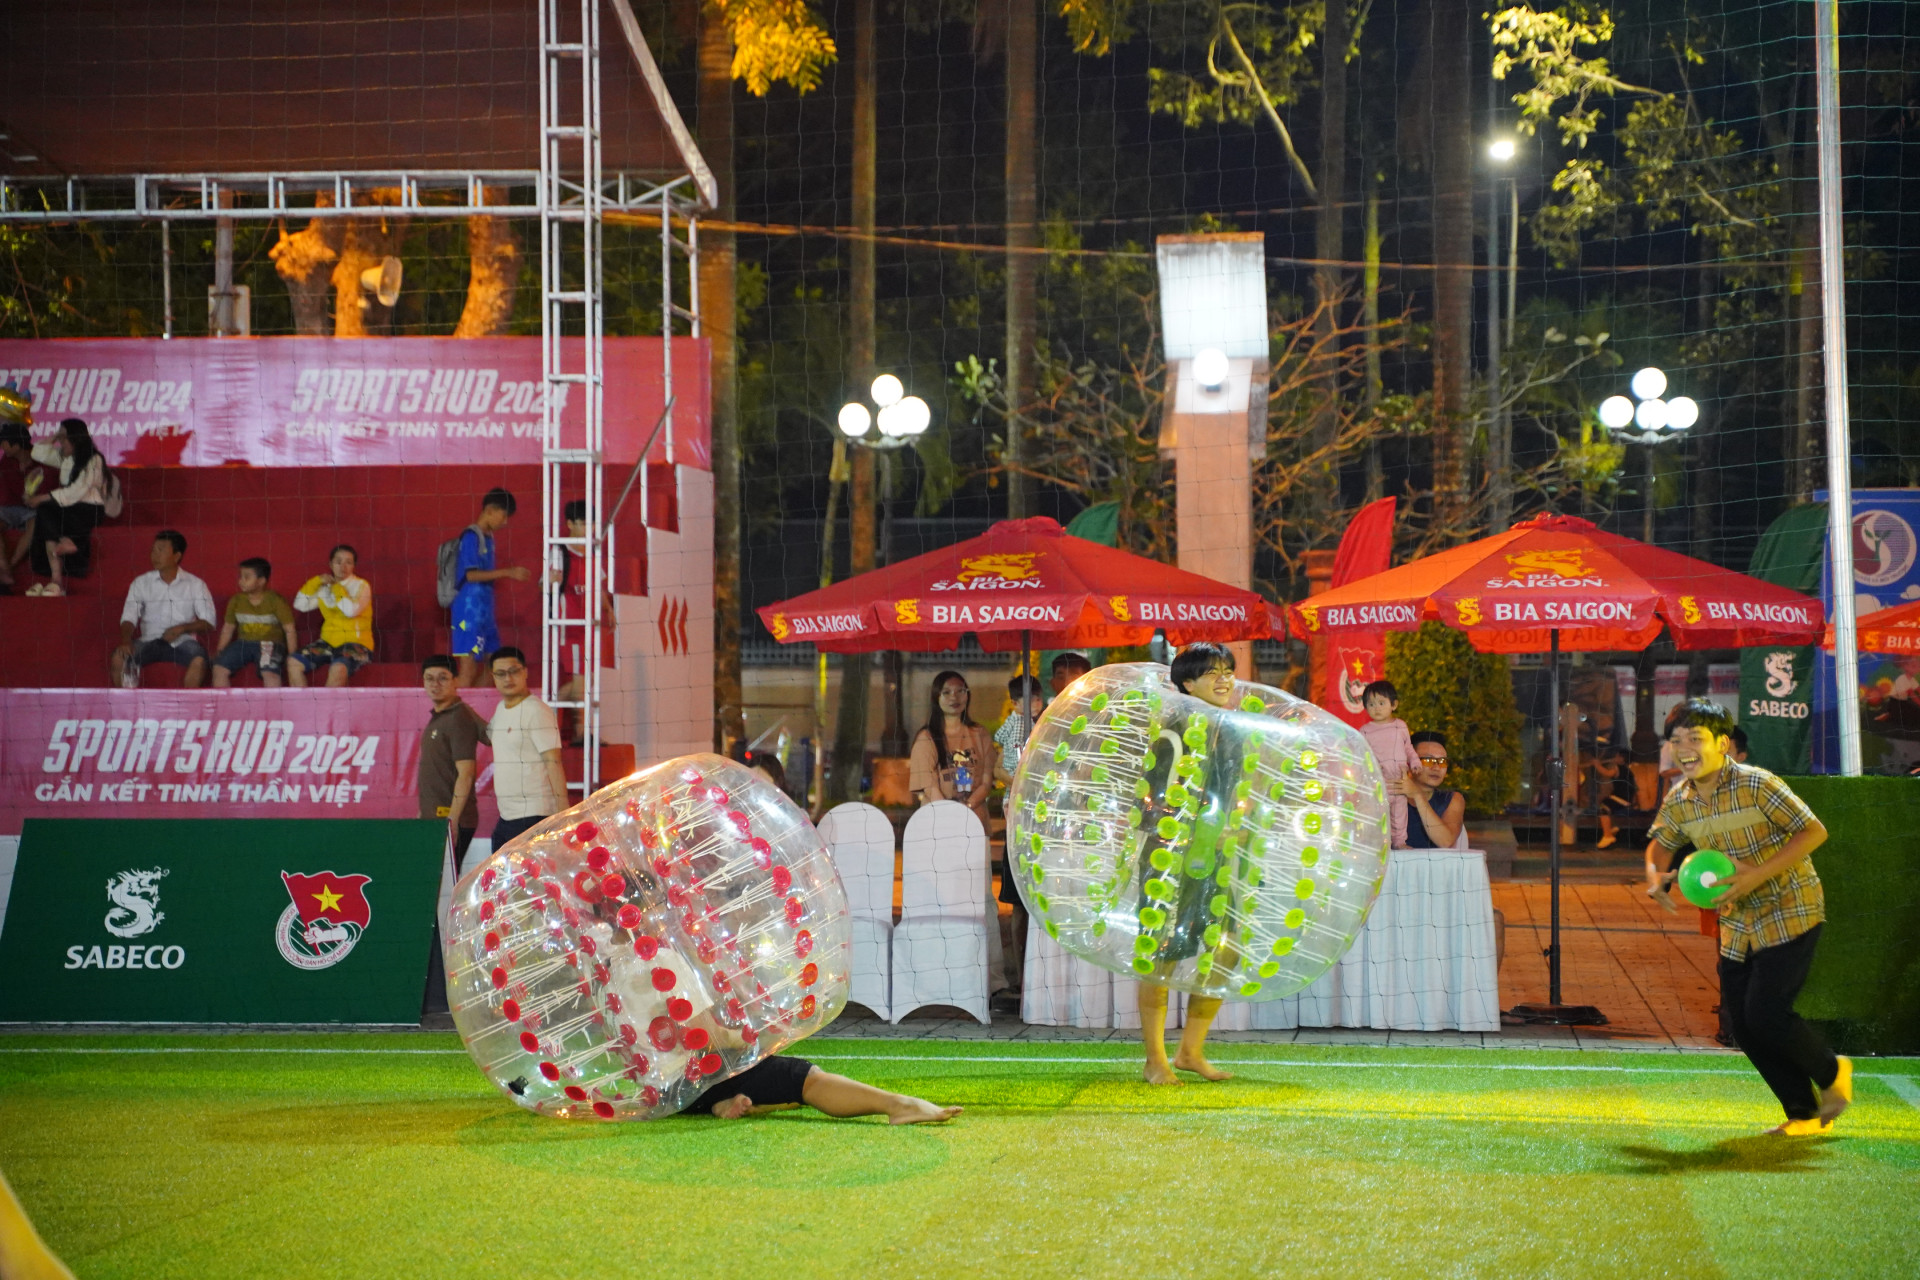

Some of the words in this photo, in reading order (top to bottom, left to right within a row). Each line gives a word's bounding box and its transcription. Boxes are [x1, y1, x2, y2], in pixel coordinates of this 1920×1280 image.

[117, 380, 192, 413] 2024
[386, 421, 438, 437] TINH
[930, 581, 1040, 591] SAIGON
[1486, 579, 1602, 588] SAIGON
[932, 605, 973, 624] BIA
[979, 605, 1060, 623] SAIGON
[1140, 603, 1175, 621] BIA
[1177, 604, 1246, 621] SAIGON
[1327, 608, 1357, 625] BIA
[1360, 605, 1416, 624] SAIGON
[1495, 603, 1540, 621] BIA
[1544, 602, 1632, 621] SAIGON
[1707, 603, 1742, 620] BIA
[1742, 603, 1808, 625] SAIGON
[793, 617, 819, 634] BIA
[817, 614, 863, 634] SAIGON
[1887, 635, 1911, 649] BIA
[1749, 699, 1809, 719] SABECO
[288, 735, 380, 774] 2024
[34, 775, 94, 803] GẮN
[99, 776, 153, 803] KẾT
[158, 783, 221, 803] TINH
[228, 777, 302, 803] THẦN
[308, 779, 369, 809] VIỆT
[64, 945, 185, 970] SABECO
